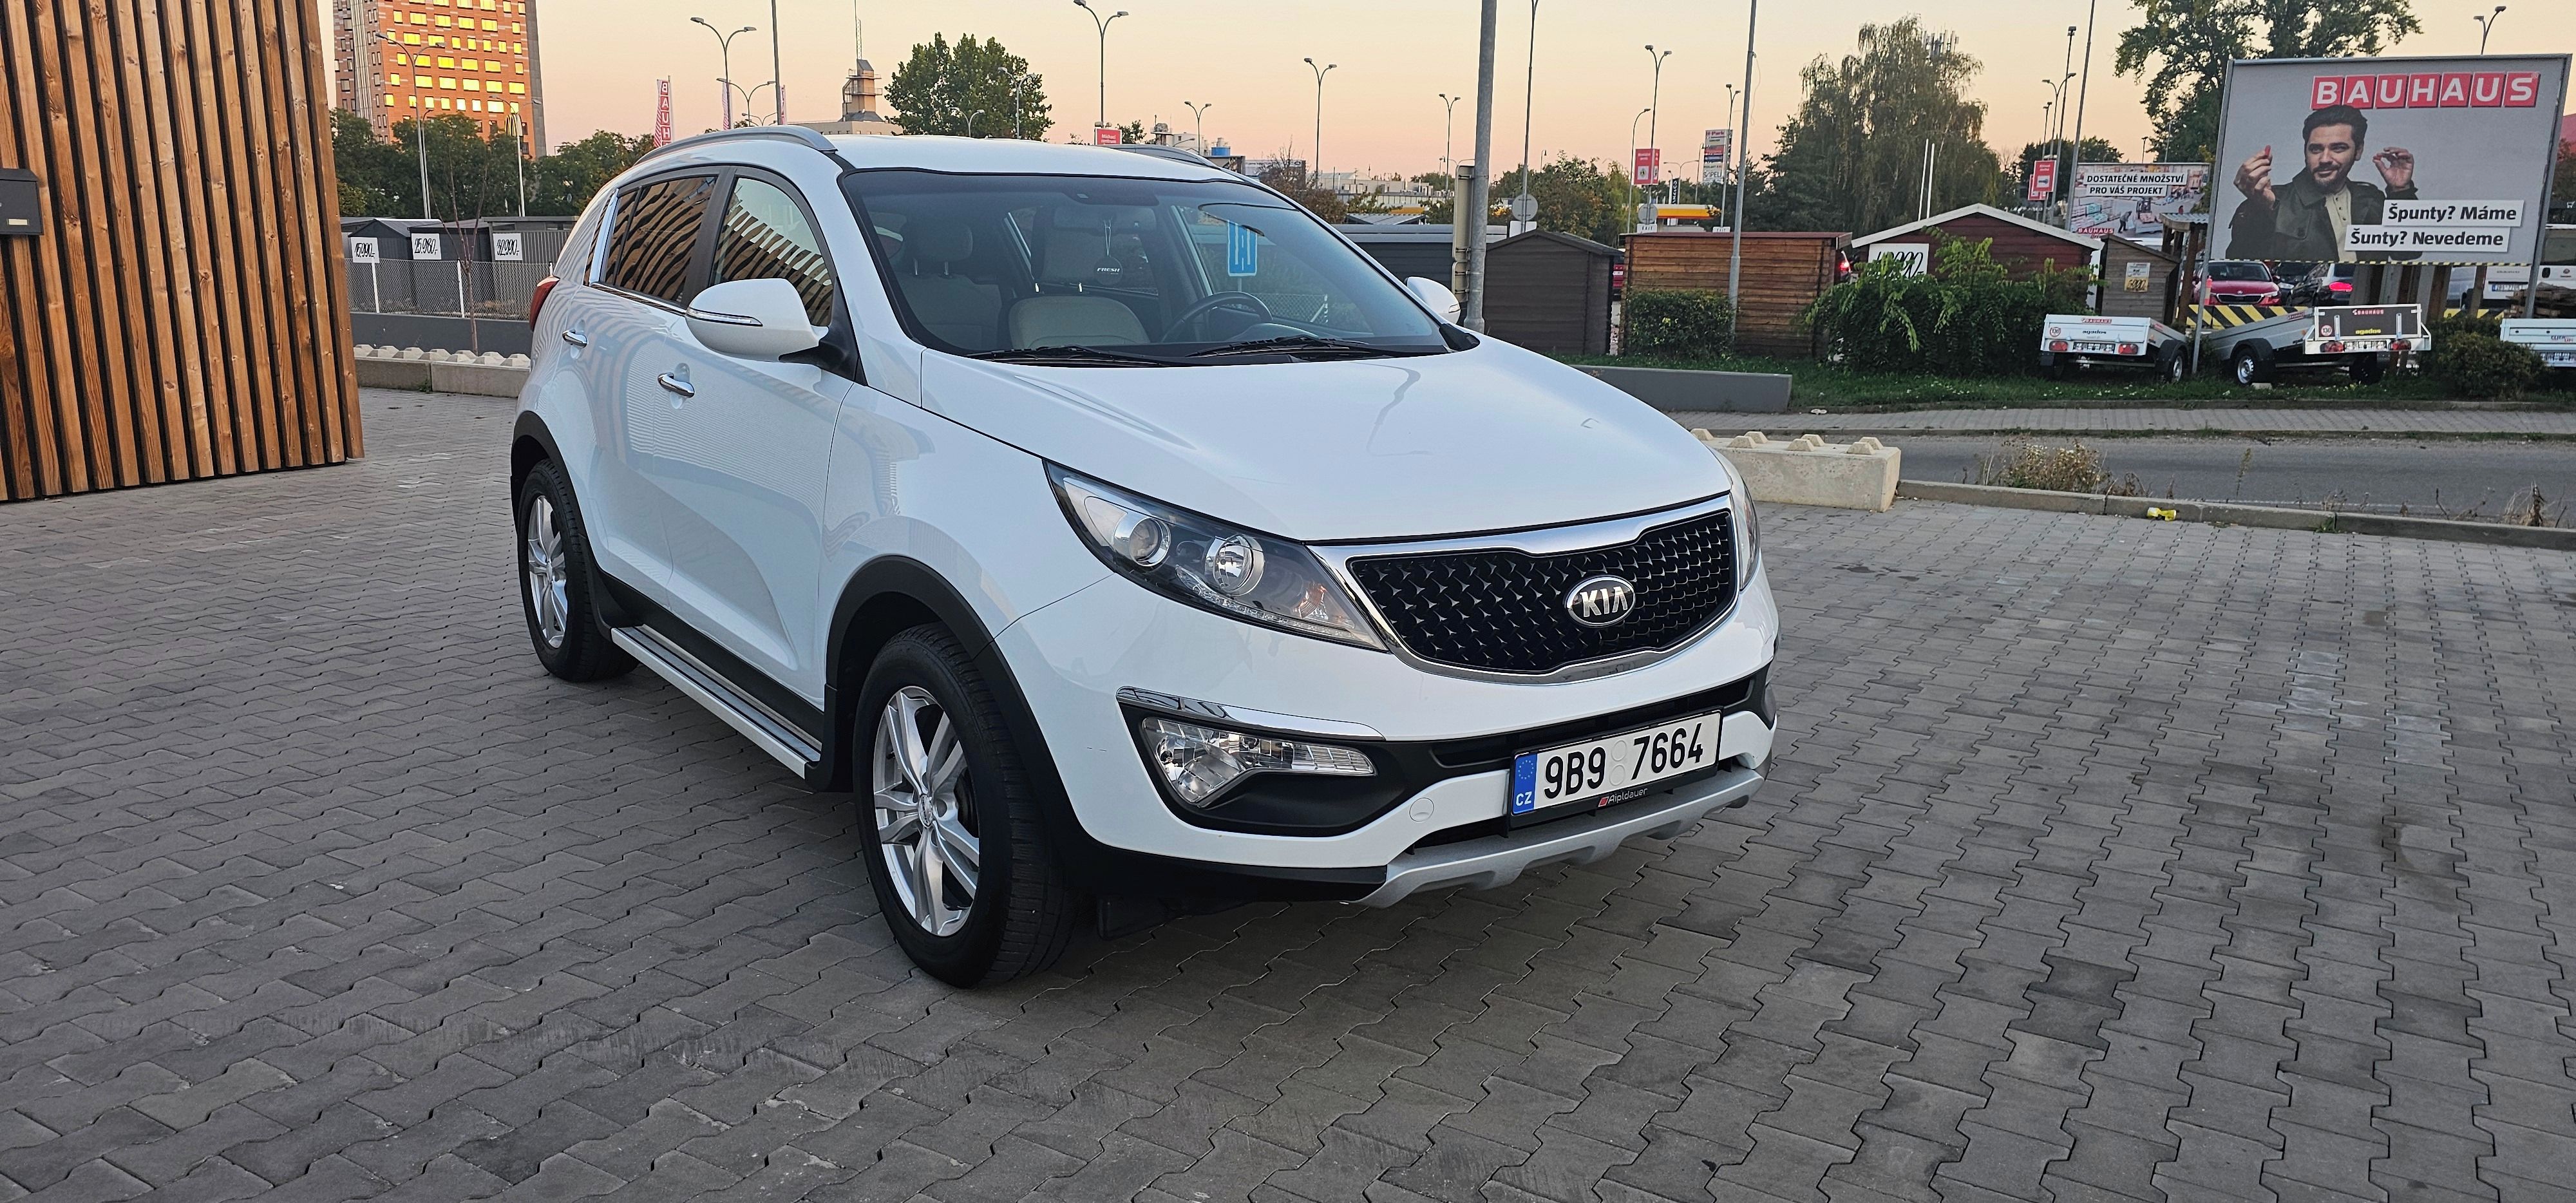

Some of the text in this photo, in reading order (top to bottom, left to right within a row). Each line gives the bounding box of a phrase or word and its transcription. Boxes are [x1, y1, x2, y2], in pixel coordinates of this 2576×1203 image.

[2316, 77, 2533, 104] BAUHAUS
[2087, 174, 2184, 183] DOSTATEČNÉ MNOŽSTVÍ
[2110, 185, 2125, 194] VÁŠ
[2388, 203, 2517, 223] Špunty? Máme
[2351, 228, 2504, 247] Šunty? Nevedeme
[1579, 586, 1628, 618] KIA
[1544, 722, 1703, 799] 9B9 7664
[1515, 791, 1532, 806] CZ
[1607, 788, 1648, 804] Aipldauer
